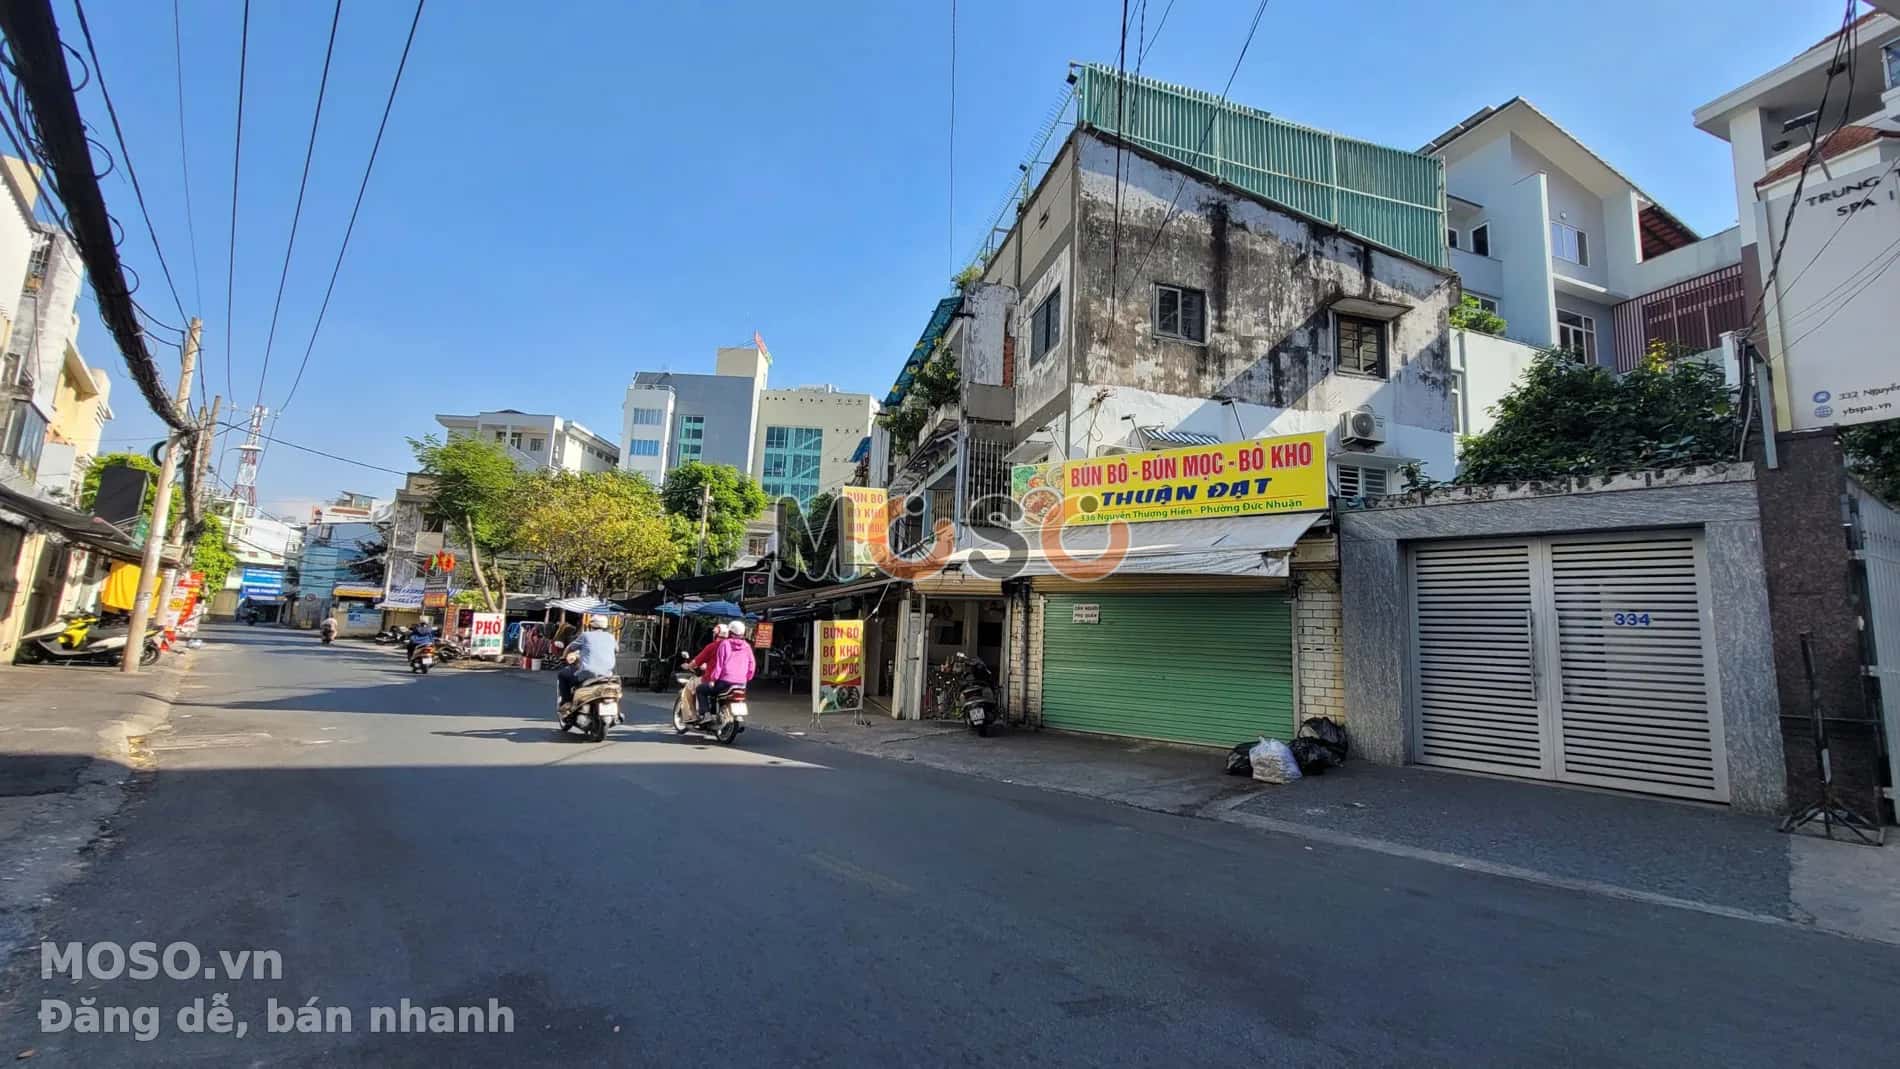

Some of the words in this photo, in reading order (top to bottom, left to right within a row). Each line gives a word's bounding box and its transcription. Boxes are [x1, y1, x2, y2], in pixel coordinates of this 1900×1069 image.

[1805, 176, 1880, 206] TRUNG
[1837, 198, 1877, 217] SPA
[1071, 462, 1102, 487] BÚN
[1107, 458, 1128, 484] BÒ
[1142, 454, 1177, 481] BÚN
[1183, 453, 1224, 481] MỌC
[1238, 442, 1265, 471] BÒ
[1271, 441, 1313, 469] KHO
[1101, 482, 1198, 505] THUẬN
[1207, 477, 1272, 499] ĐẠT
[474, 615, 502, 635] PHỞ
[1614, 612, 1649, 626] 334
